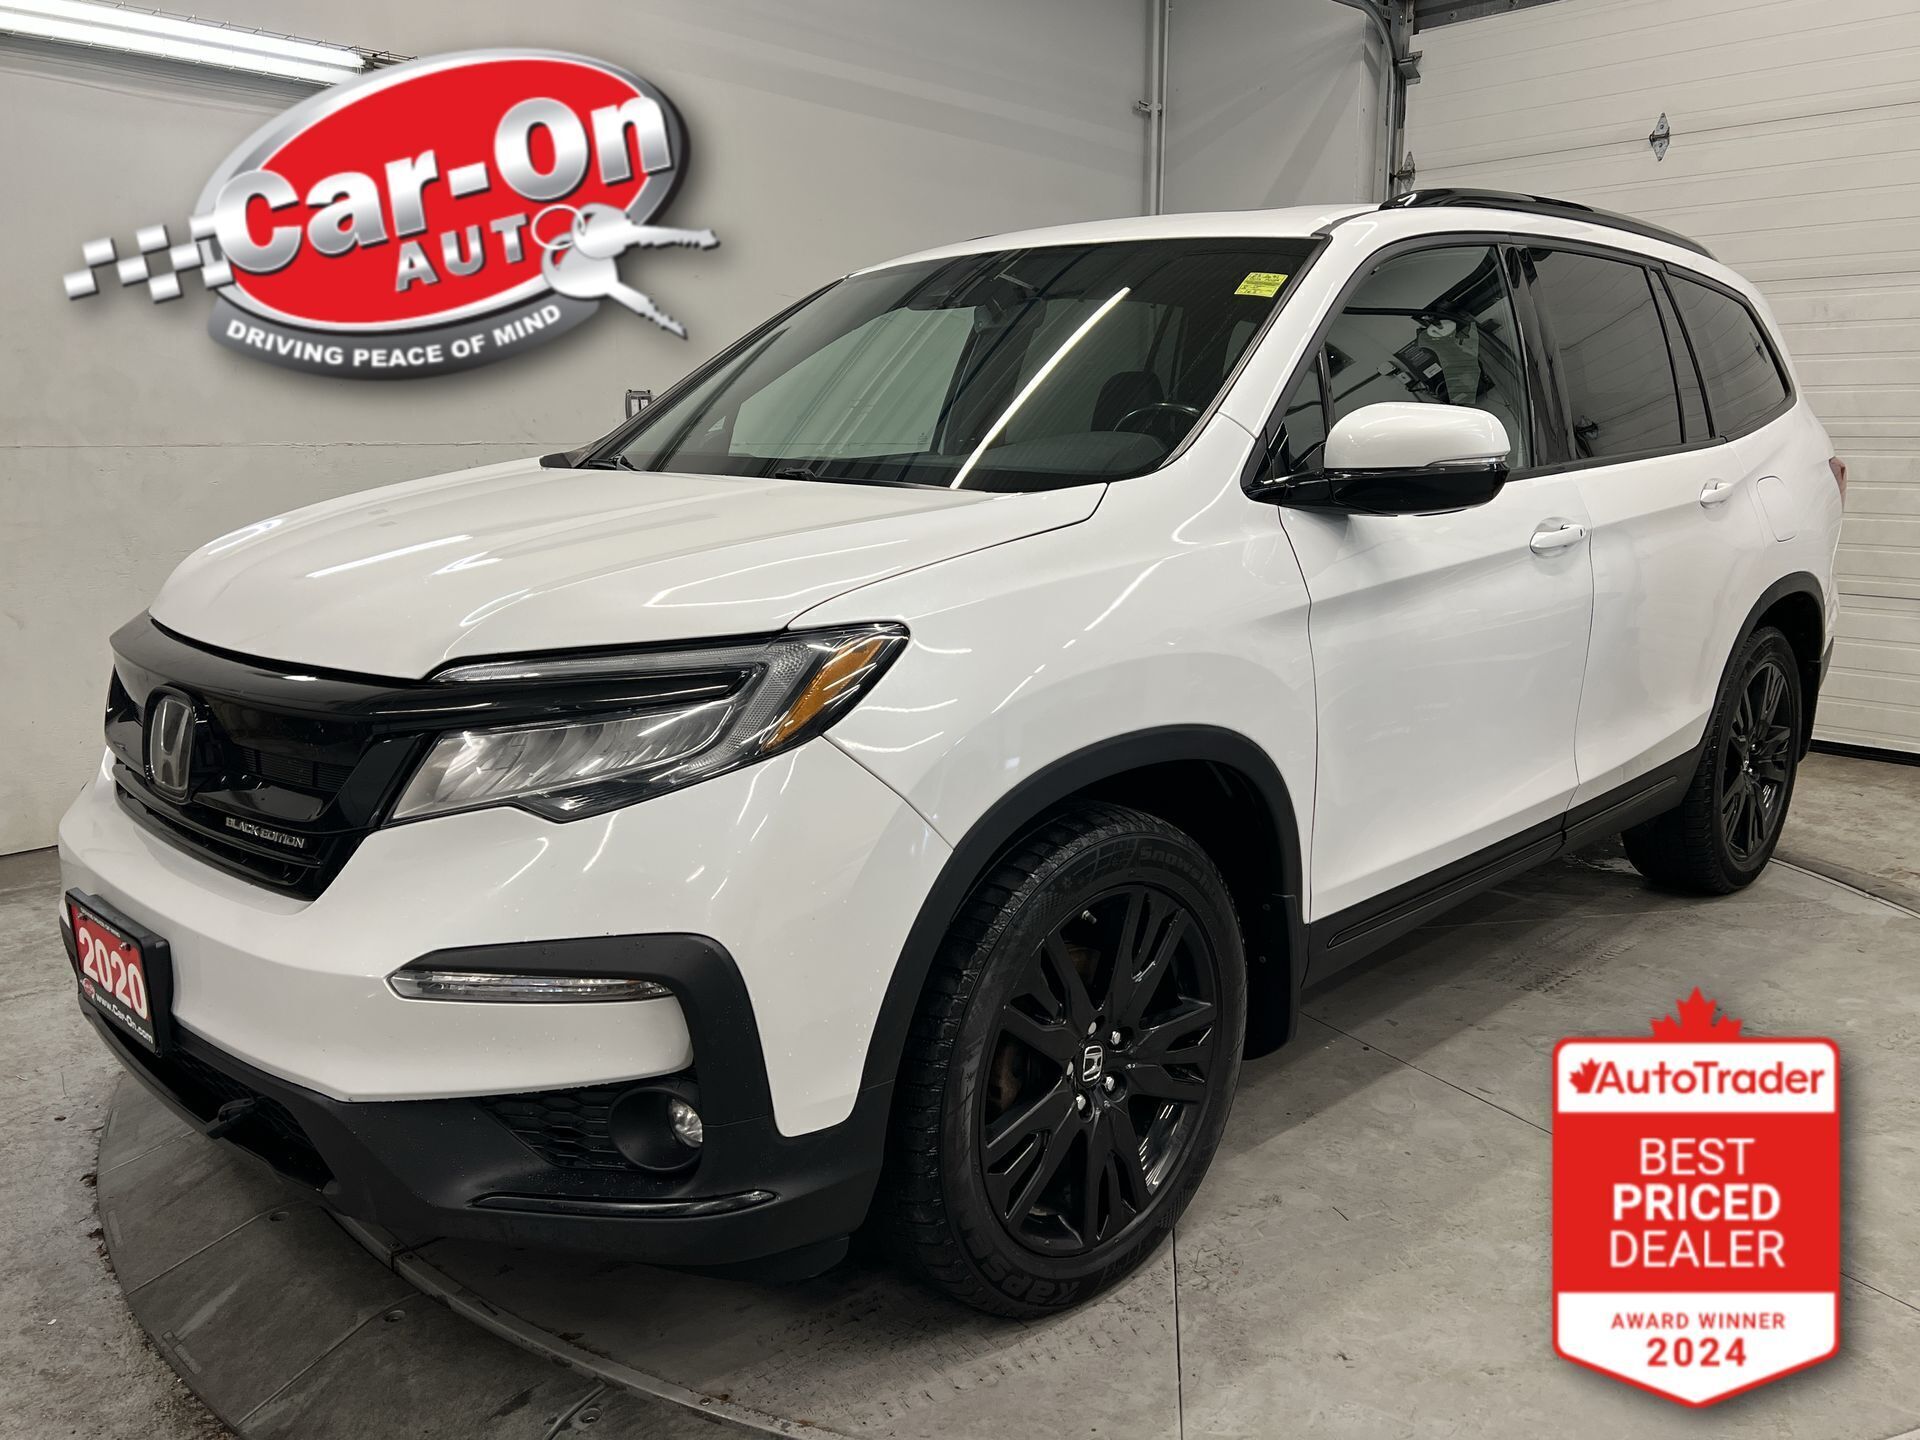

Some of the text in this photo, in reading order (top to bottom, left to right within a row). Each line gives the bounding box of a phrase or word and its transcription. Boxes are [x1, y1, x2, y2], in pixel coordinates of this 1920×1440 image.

[225, 816, 305, 848] BLACK EDITION
[78, 926, 147, 1020] 2020
